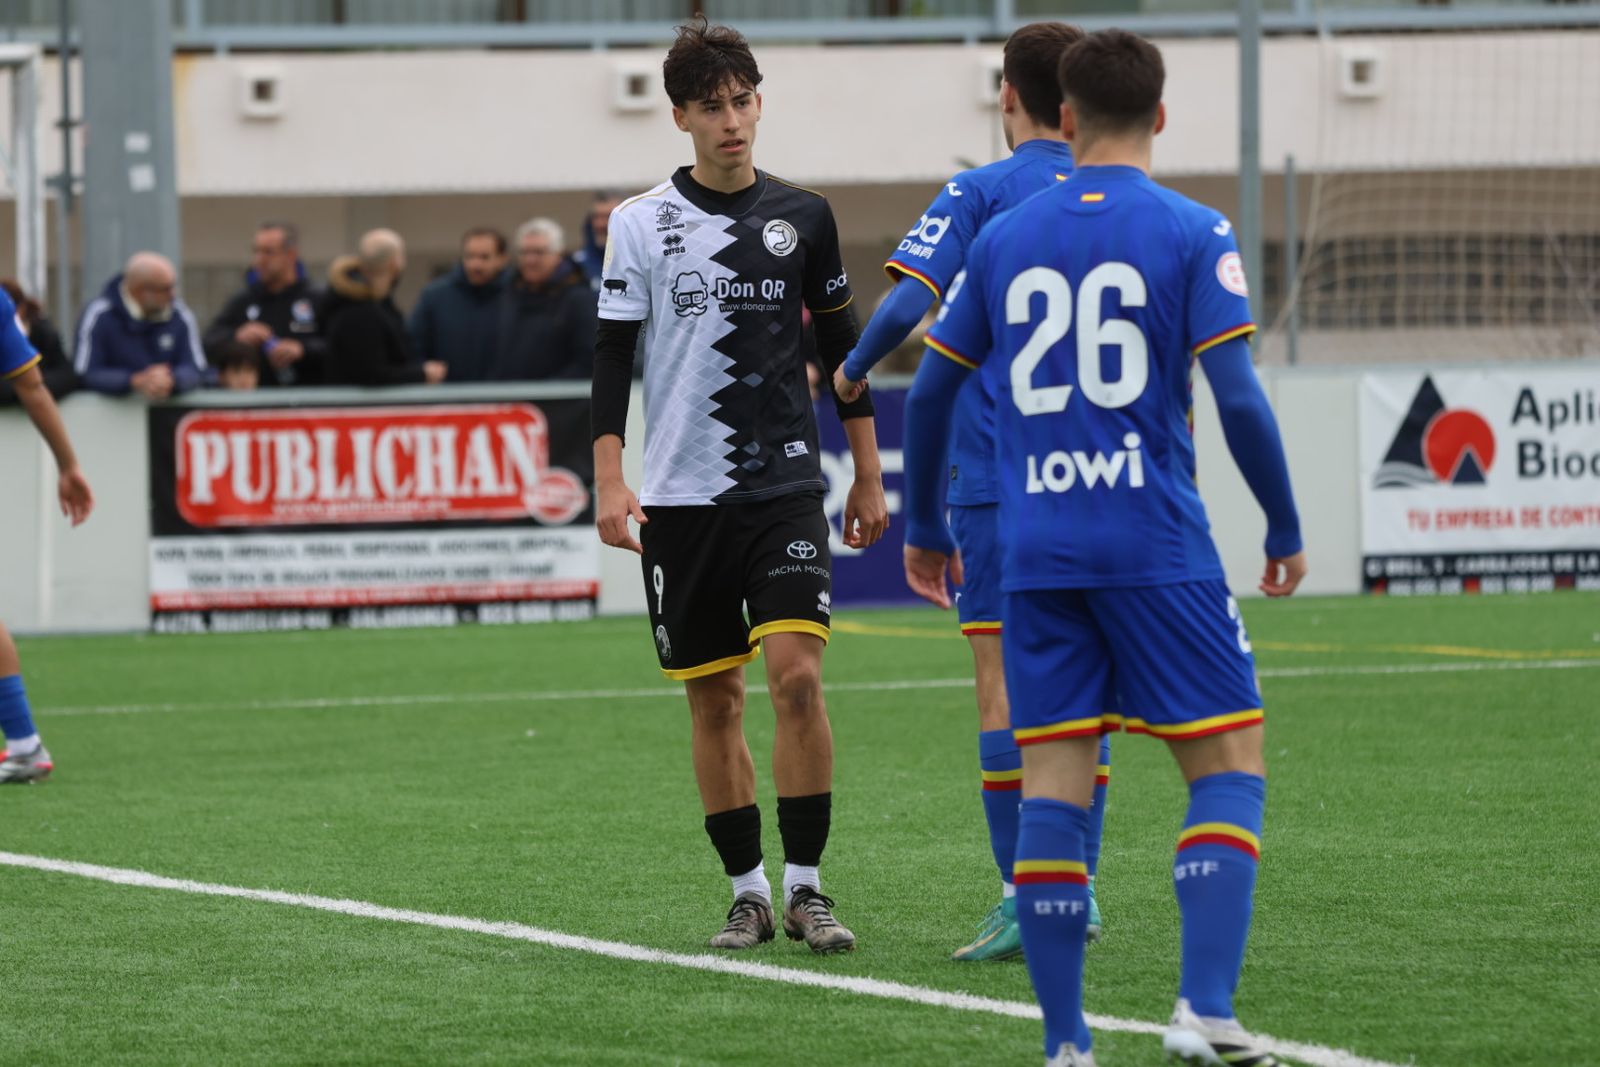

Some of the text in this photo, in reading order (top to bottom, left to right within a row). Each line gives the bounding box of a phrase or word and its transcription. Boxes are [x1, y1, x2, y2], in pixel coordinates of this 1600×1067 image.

[663, 246, 686, 257] errea
[716, 278, 786, 301] Don QR
[720, 302, 781, 313] www.donqr.com
[1006, 261, 1149, 417] 26
[1511, 387, 1600, 432] Apli
[187, 419, 547, 505] PUBLICHAN
[1407, 508, 1430, 531] TU
[1435, 507, 1515, 530] EMPRESA
[1520, 507, 1543, 528] DE
[768, 564, 802, 578] HACHA
[653, 564, 664, 615] 9
[1173, 860, 1220, 881] GTF
[1034, 899, 1085, 916] GTF
